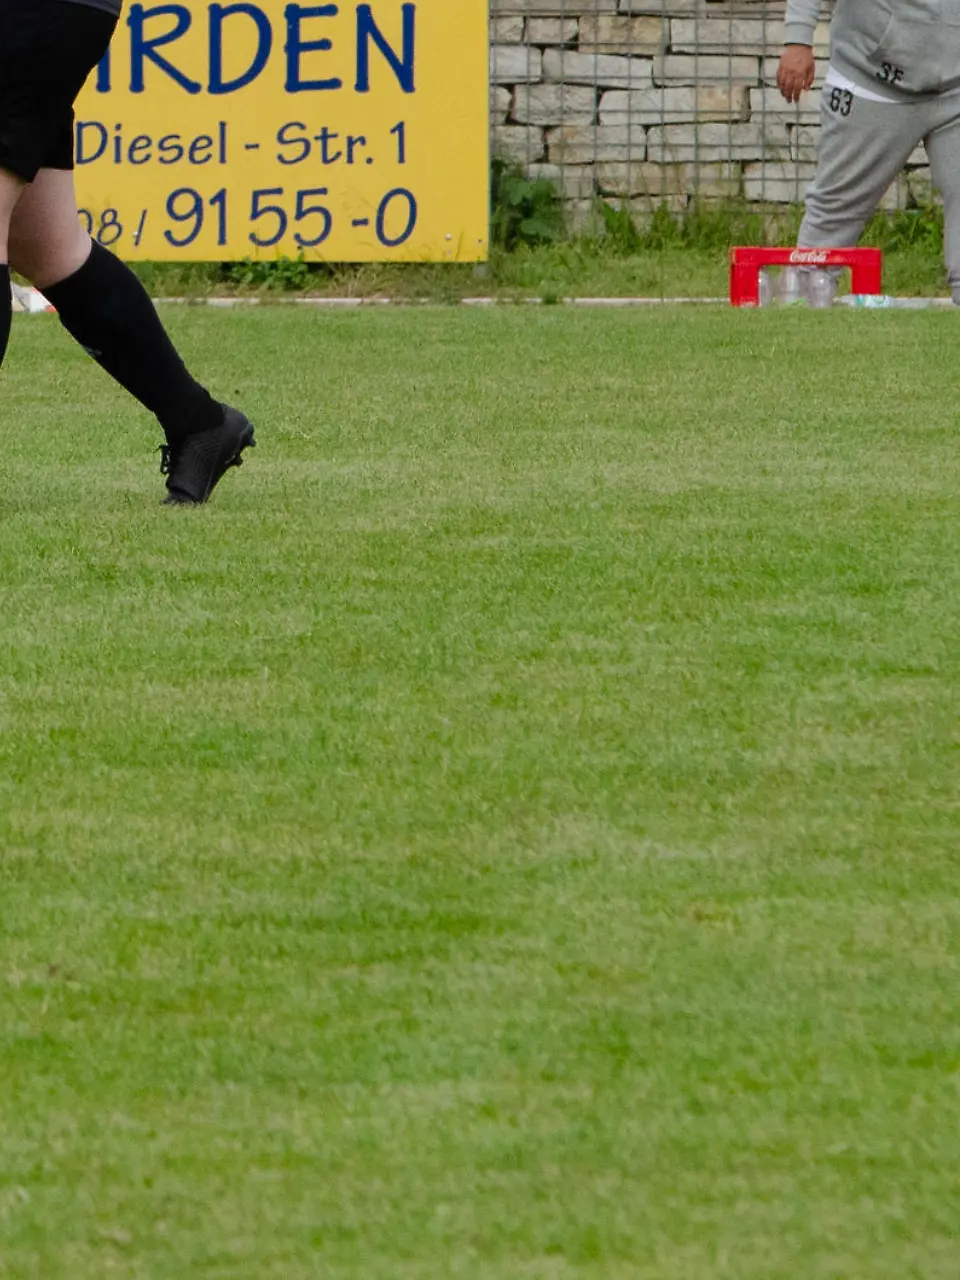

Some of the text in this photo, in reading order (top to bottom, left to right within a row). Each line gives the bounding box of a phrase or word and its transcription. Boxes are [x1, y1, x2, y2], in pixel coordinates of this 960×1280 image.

[75, 121, 227, 165] Diesel
[275, 121, 374, 165] Str.
[389, 120, 407, 165] 1
